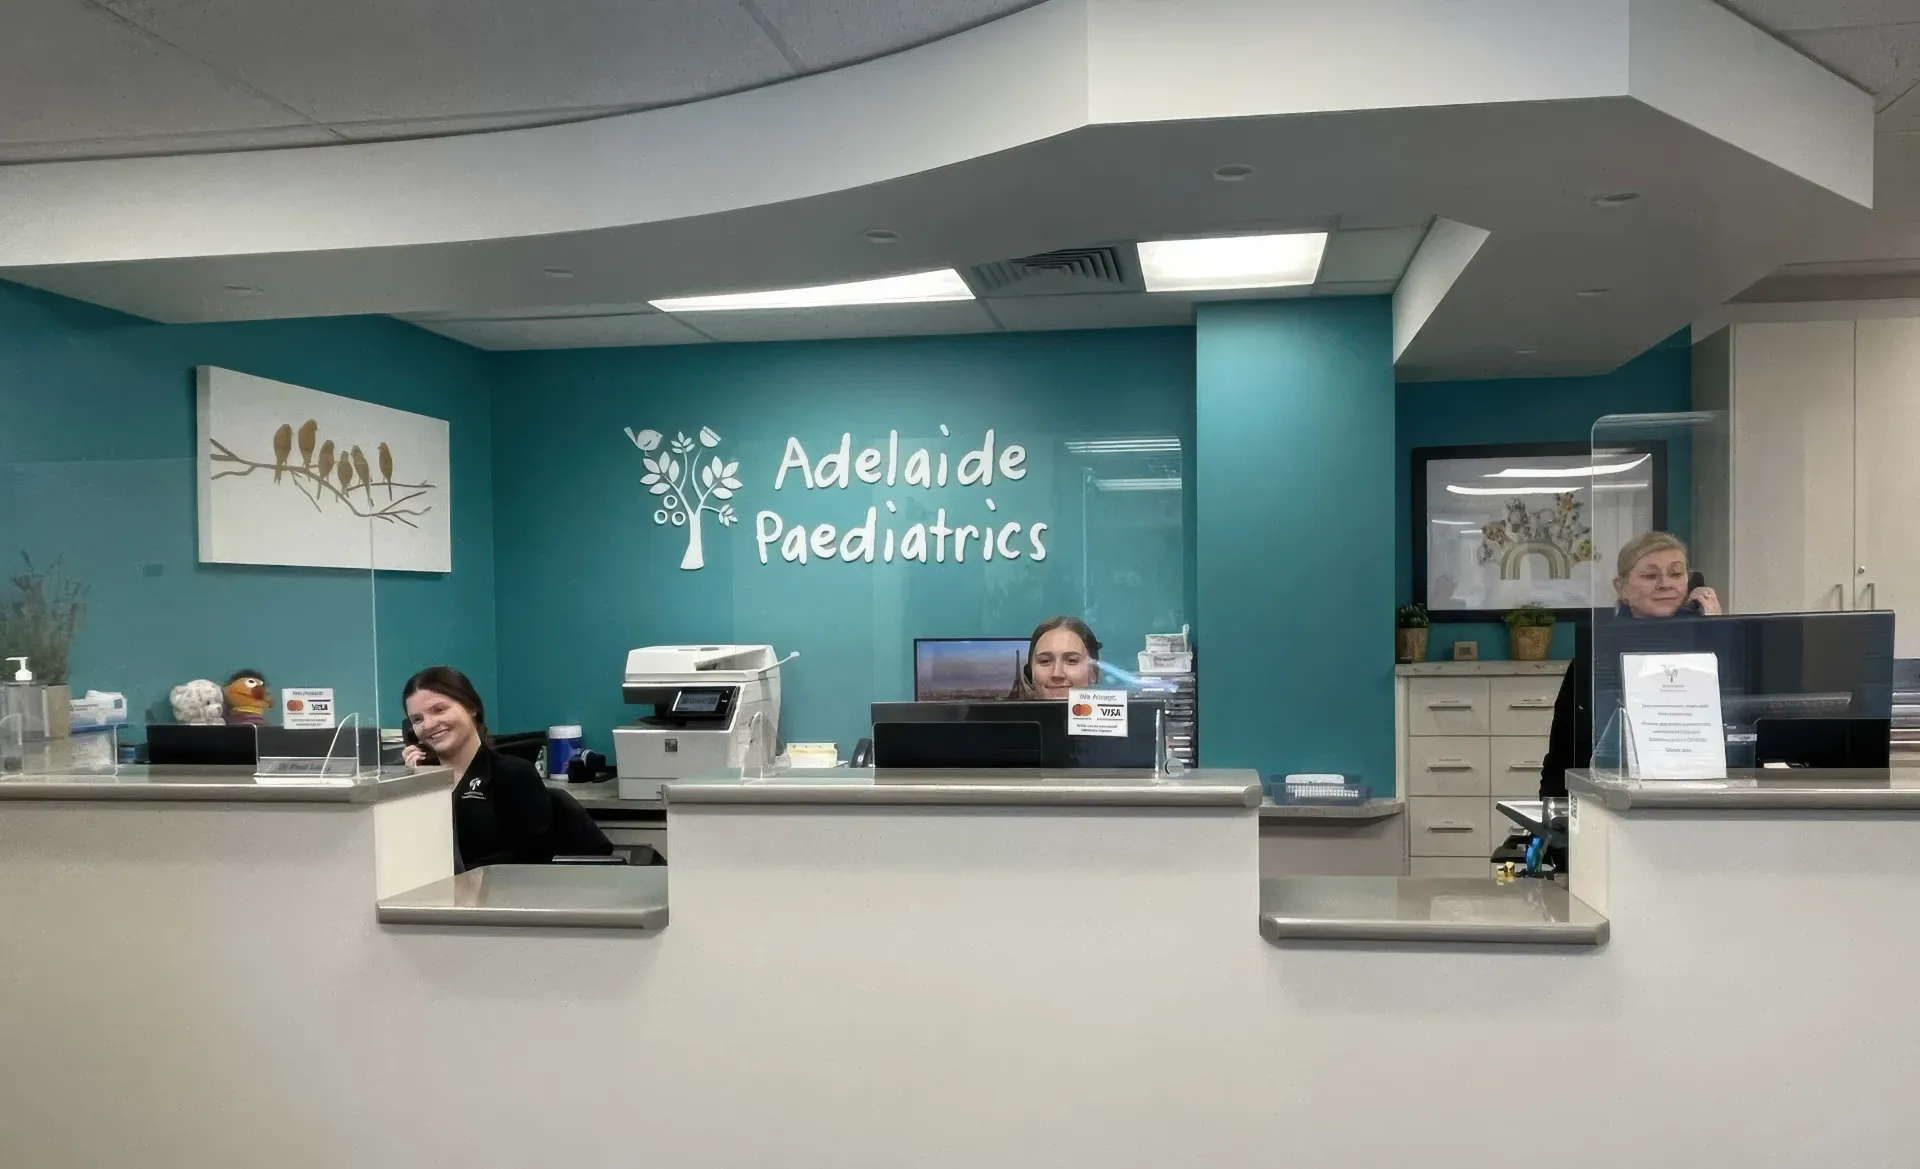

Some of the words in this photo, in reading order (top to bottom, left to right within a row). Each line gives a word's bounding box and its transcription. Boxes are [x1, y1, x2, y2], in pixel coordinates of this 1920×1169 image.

[775, 424, 1027, 490] Adelaide
[756, 498, 1048, 564] Paediatrics
[1100, 708, 1121, 717] VISA
